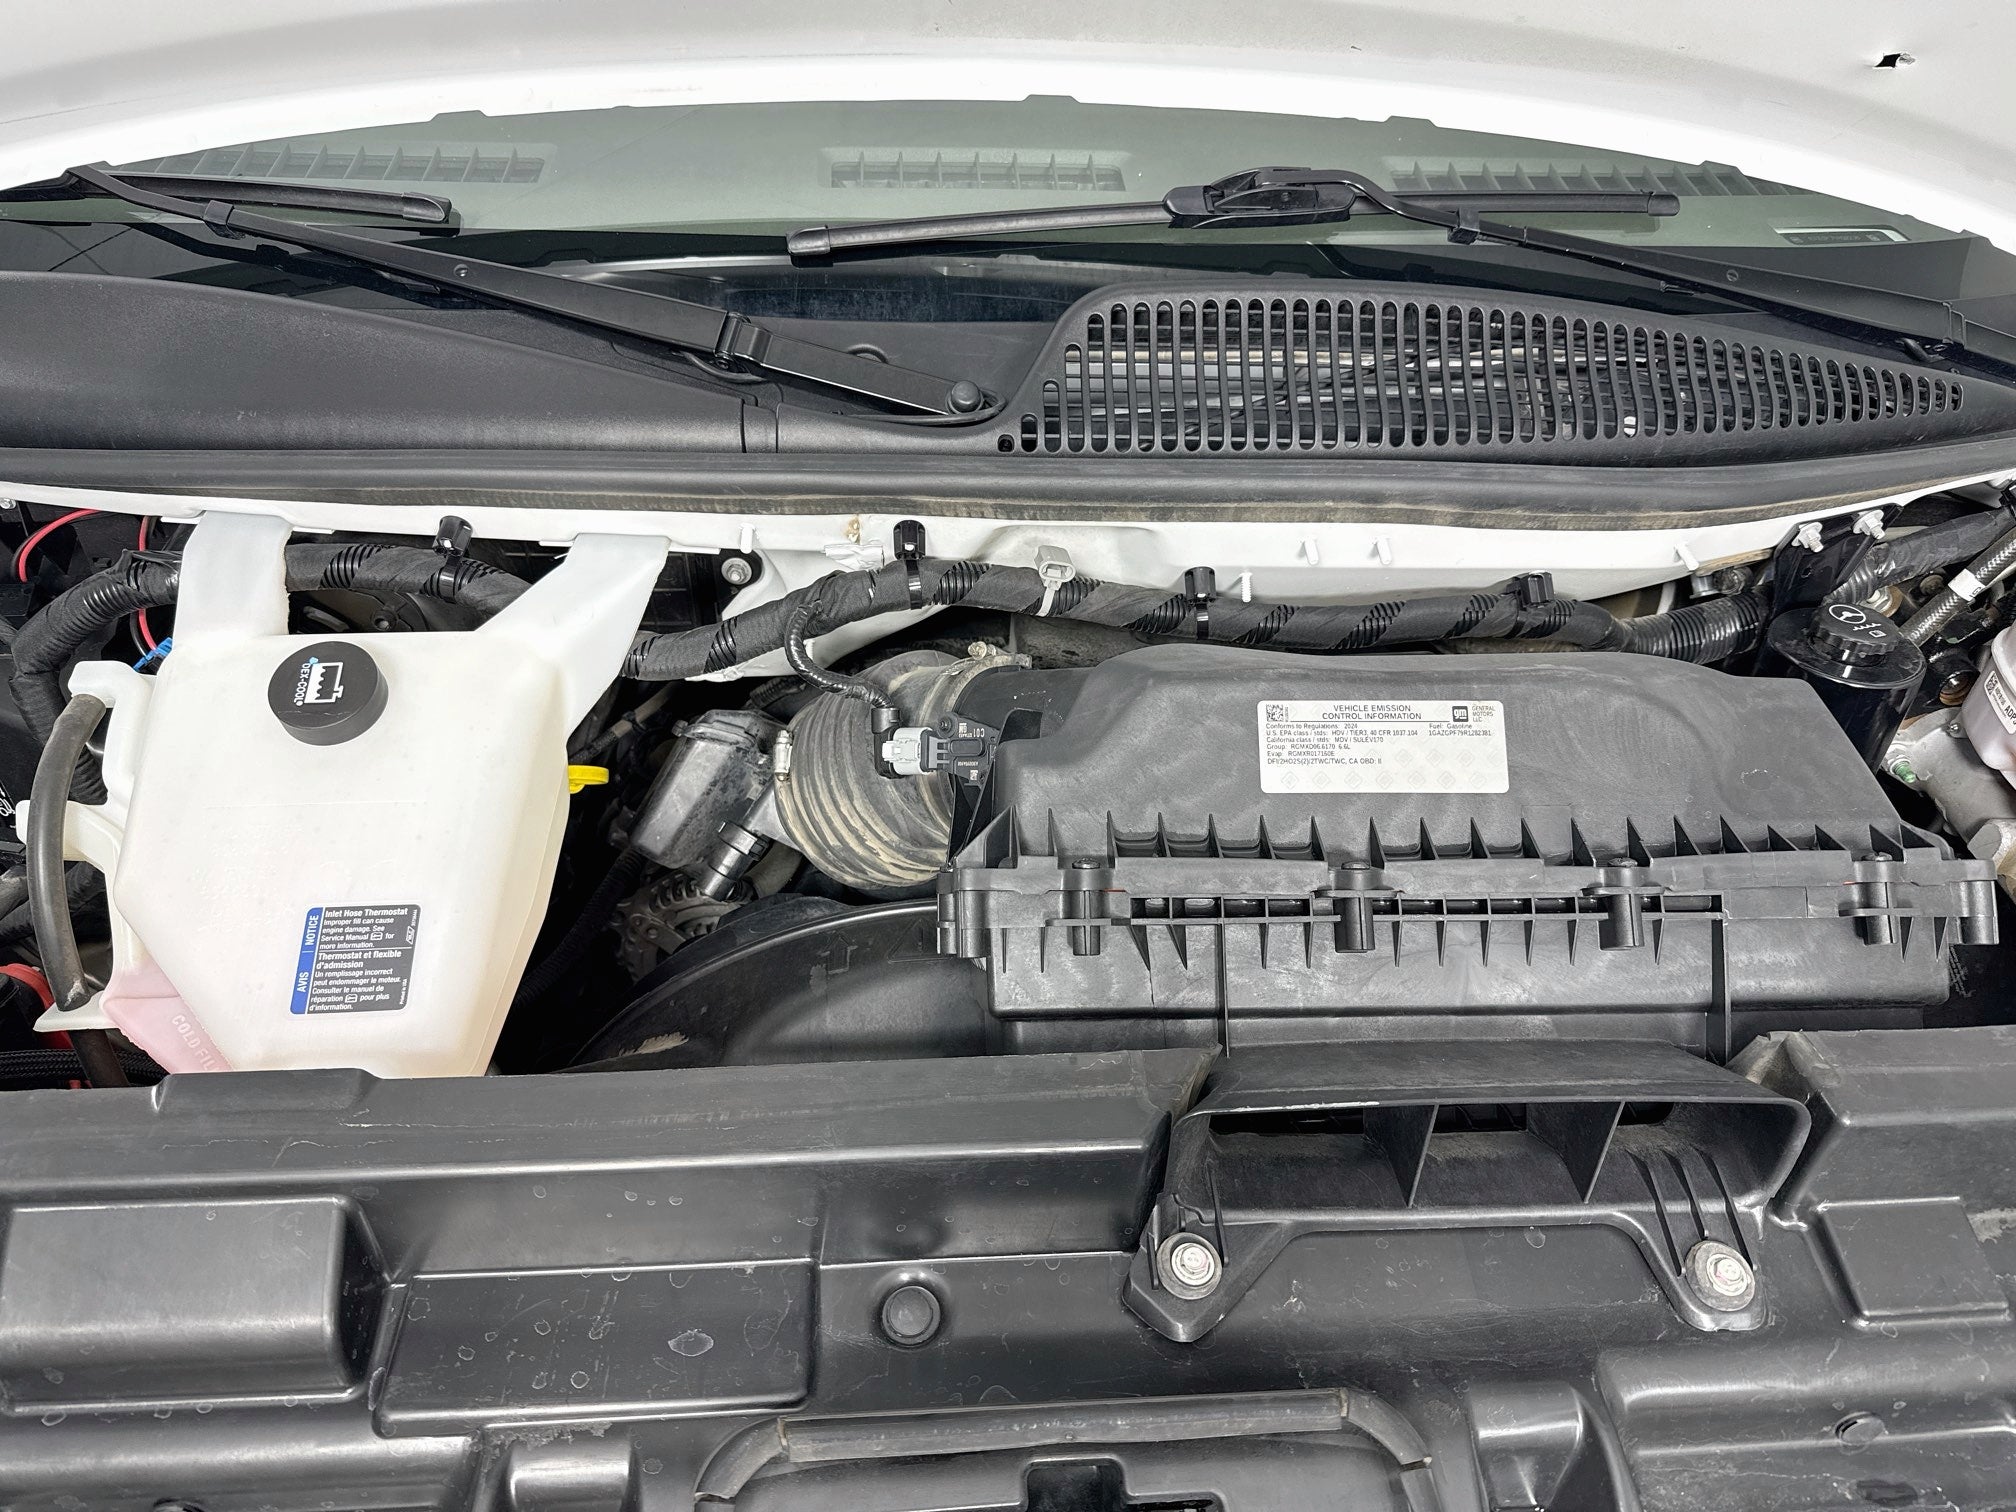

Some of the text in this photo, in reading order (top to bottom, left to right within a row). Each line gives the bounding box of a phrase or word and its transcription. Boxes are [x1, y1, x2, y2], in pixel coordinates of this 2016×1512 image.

[306, 915, 319, 946] NOTICE
[318, 952, 362, 960] Thermostat
[316, 961, 364, 969] d'admission
[297, 972, 309, 992] AVIS
[329, 978, 370, 986] endommager
[311, 995, 343, 1003] réparation
[172, 1014, 201, 1048] COLD
